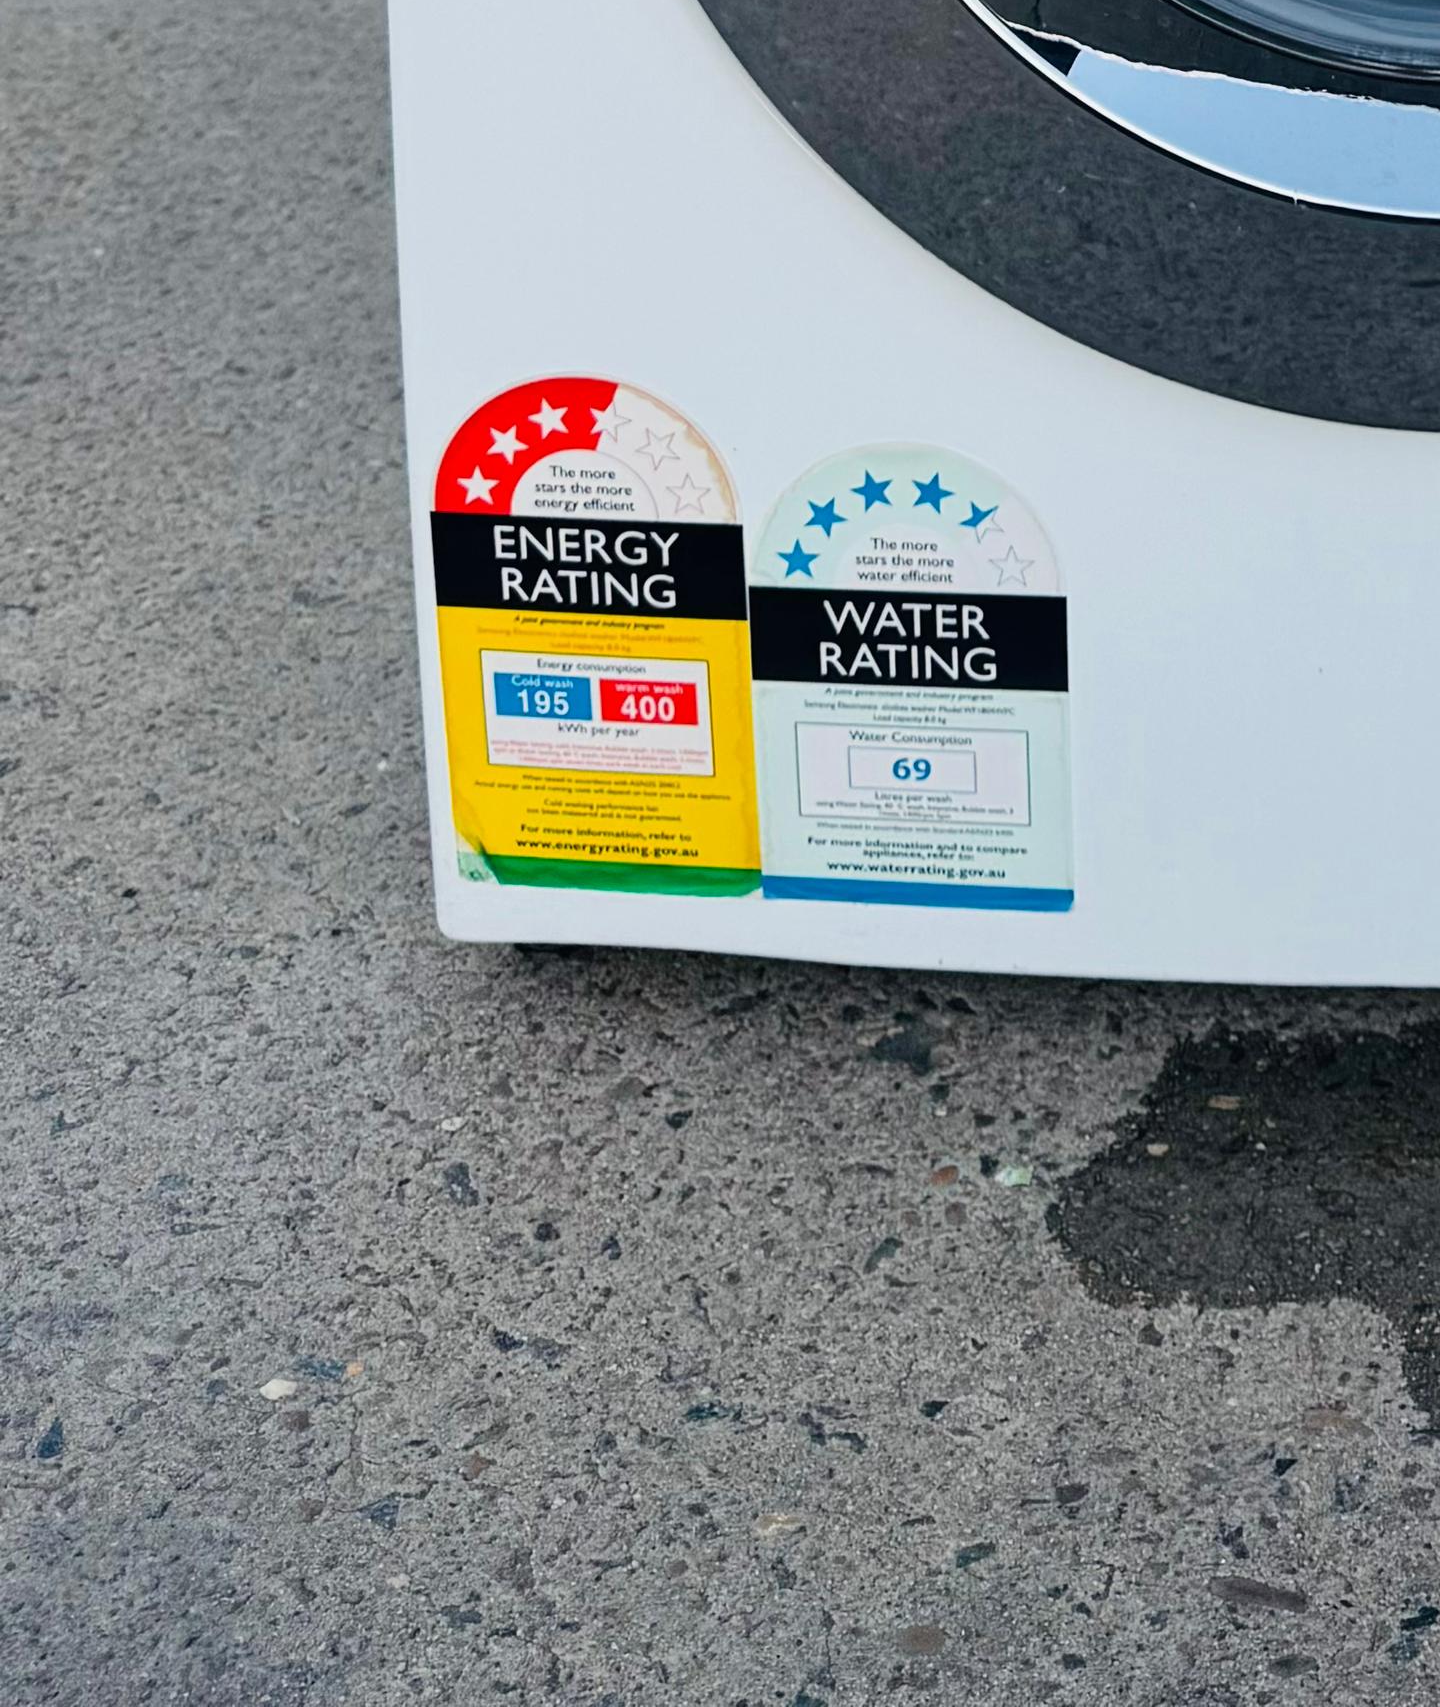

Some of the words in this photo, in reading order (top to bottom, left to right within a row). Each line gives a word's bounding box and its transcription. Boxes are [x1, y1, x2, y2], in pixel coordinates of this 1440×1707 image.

[549, 465, 576, 478] The
[579, 469, 616, 480] more
[535, 483, 565, 494] stars
[570, 482, 592, 495] the
[596, 486, 632, 496] more
[534, 499, 579, 513] energy
[583, 498, 635, 512] efficient
[493, 524, 680, 566] ENERGY
[873, 537, 897, 550] The
[901, 541, 938, 552] more
[855, 555, 887, 566] stars
[891, 554, 914, 567] the
[922, 558, 954, 568] more
[857, 571, 895, 581] water
[900, 570, 953, 583] efficient
[501, 568, 677, 610] RATING
[823, 599, 990, 640] WATER
[537, 658, 573, 671] Energy
[575, 662, 646, 675] consumption
[818, 643, 997, 682] RATING
[511, 675, 541, 688] Cold
[544, 679, 573, 689] wash
[516, 690, 570, 716] 195
[620, 695, 676, 722] 400
[557, 722, 587, 734] kWh
[591, 726, 610, 736] per
[615, 728, 640, 737] year
[850, 730, 887, 743] Water
[891, 731, 972, 745] Consumption
[892, 757, 933, 781] 69
[516, 839, 699, 858] www.energyrating.gov.au
[827, 861, 1006, 879] www.waterrating.gov.au
